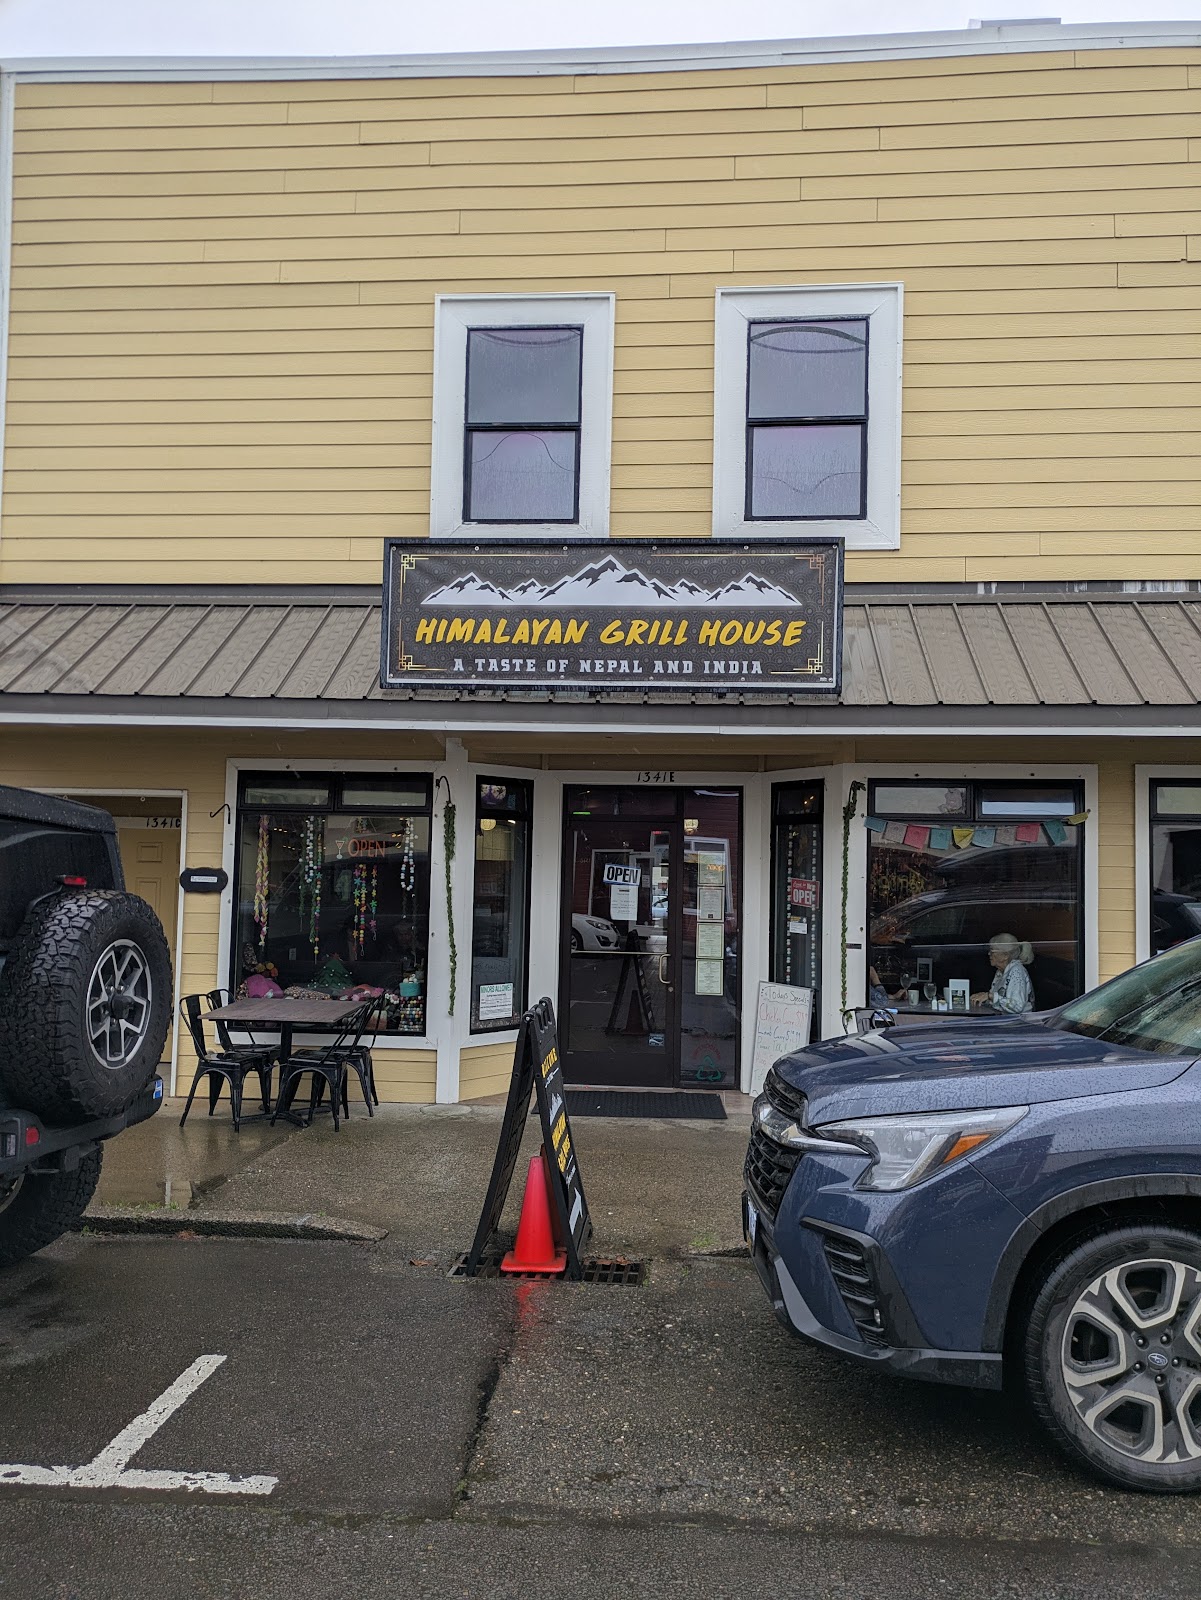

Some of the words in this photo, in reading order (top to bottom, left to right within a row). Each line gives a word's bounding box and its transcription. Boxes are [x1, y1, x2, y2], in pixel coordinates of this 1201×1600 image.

[415, 617, 590, 646] HIMALAYAN
[599, 619, 689, 647] GRILL
[698, 619, 807, 647] HOUSE
[453, 658, 465, 672] A
[475, 658, 537, 673] TASTE
[546, 659, 569, 673] OF
[579, 659, 643, 673] NEPAL
[653, 660, 693, 674] AND
[703, 660, 763, 674] INDIA
[637, 771, 675, 783] 1341E
[347, 838, 386, 858] OPEN
[606, 866, 639, 884] OPEN
